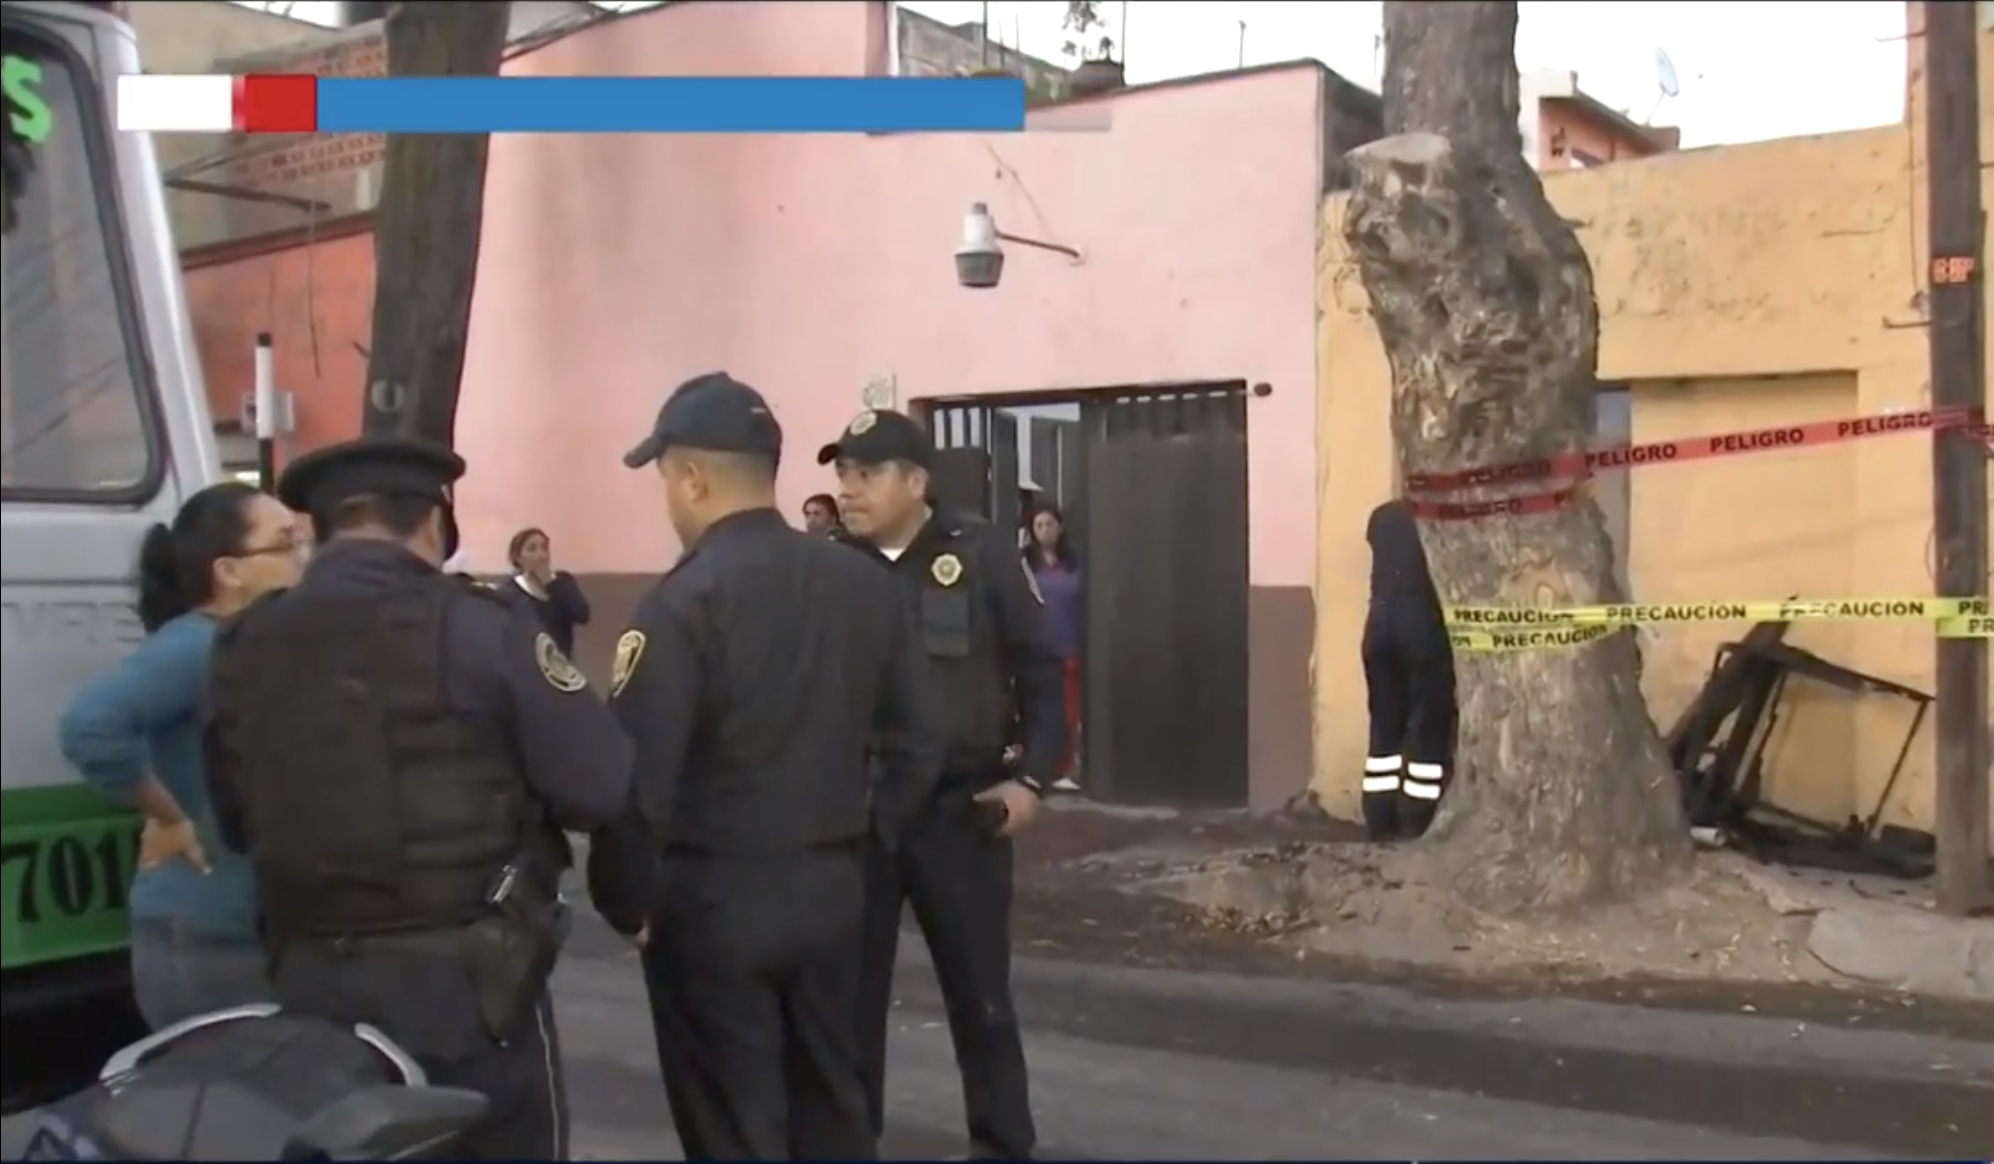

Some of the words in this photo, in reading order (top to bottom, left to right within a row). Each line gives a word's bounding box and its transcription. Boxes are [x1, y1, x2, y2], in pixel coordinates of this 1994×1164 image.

[1584, 443, 1678, 470] PELIGRO
[1710, 427, 1805, 453] PELIGRO
[1838, 411, 1934, 437] PELIGRO
